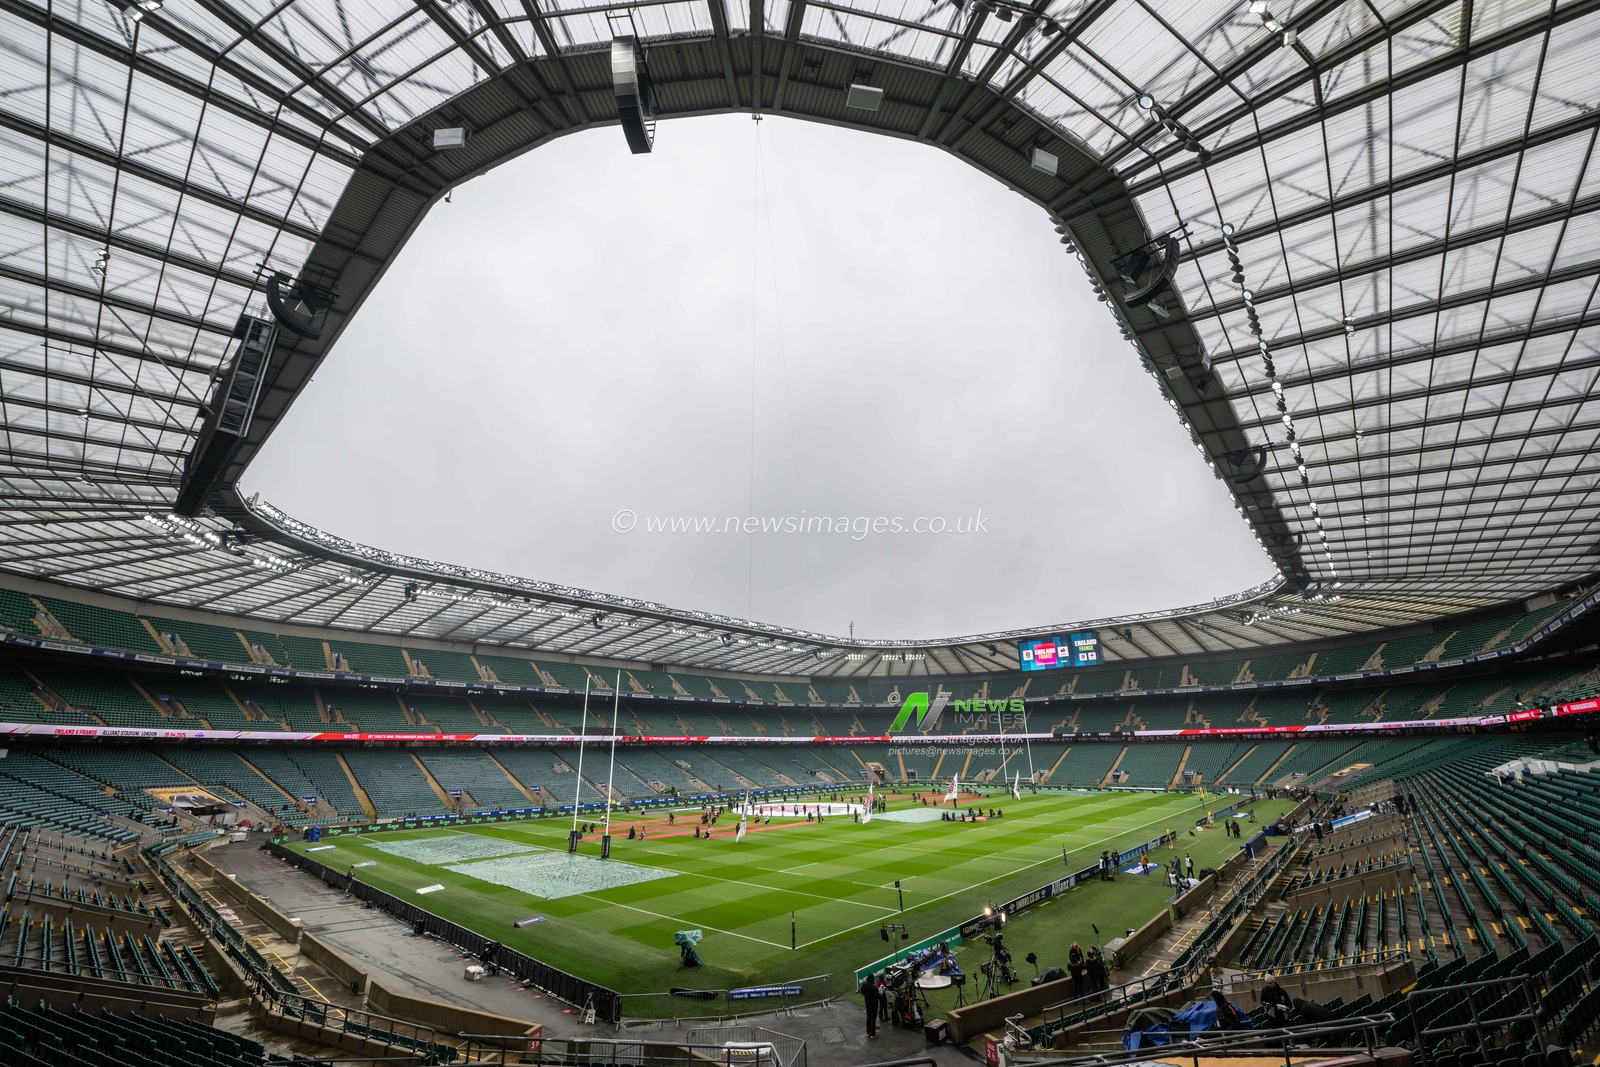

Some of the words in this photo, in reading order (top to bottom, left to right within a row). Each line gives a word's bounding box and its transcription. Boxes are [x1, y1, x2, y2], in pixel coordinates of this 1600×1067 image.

[1074, 639, 1097, 647] ENGLAND
[1034, 647, 1056, 656] ENGLAND
[1051, 880, 1069, 896] Allianz
